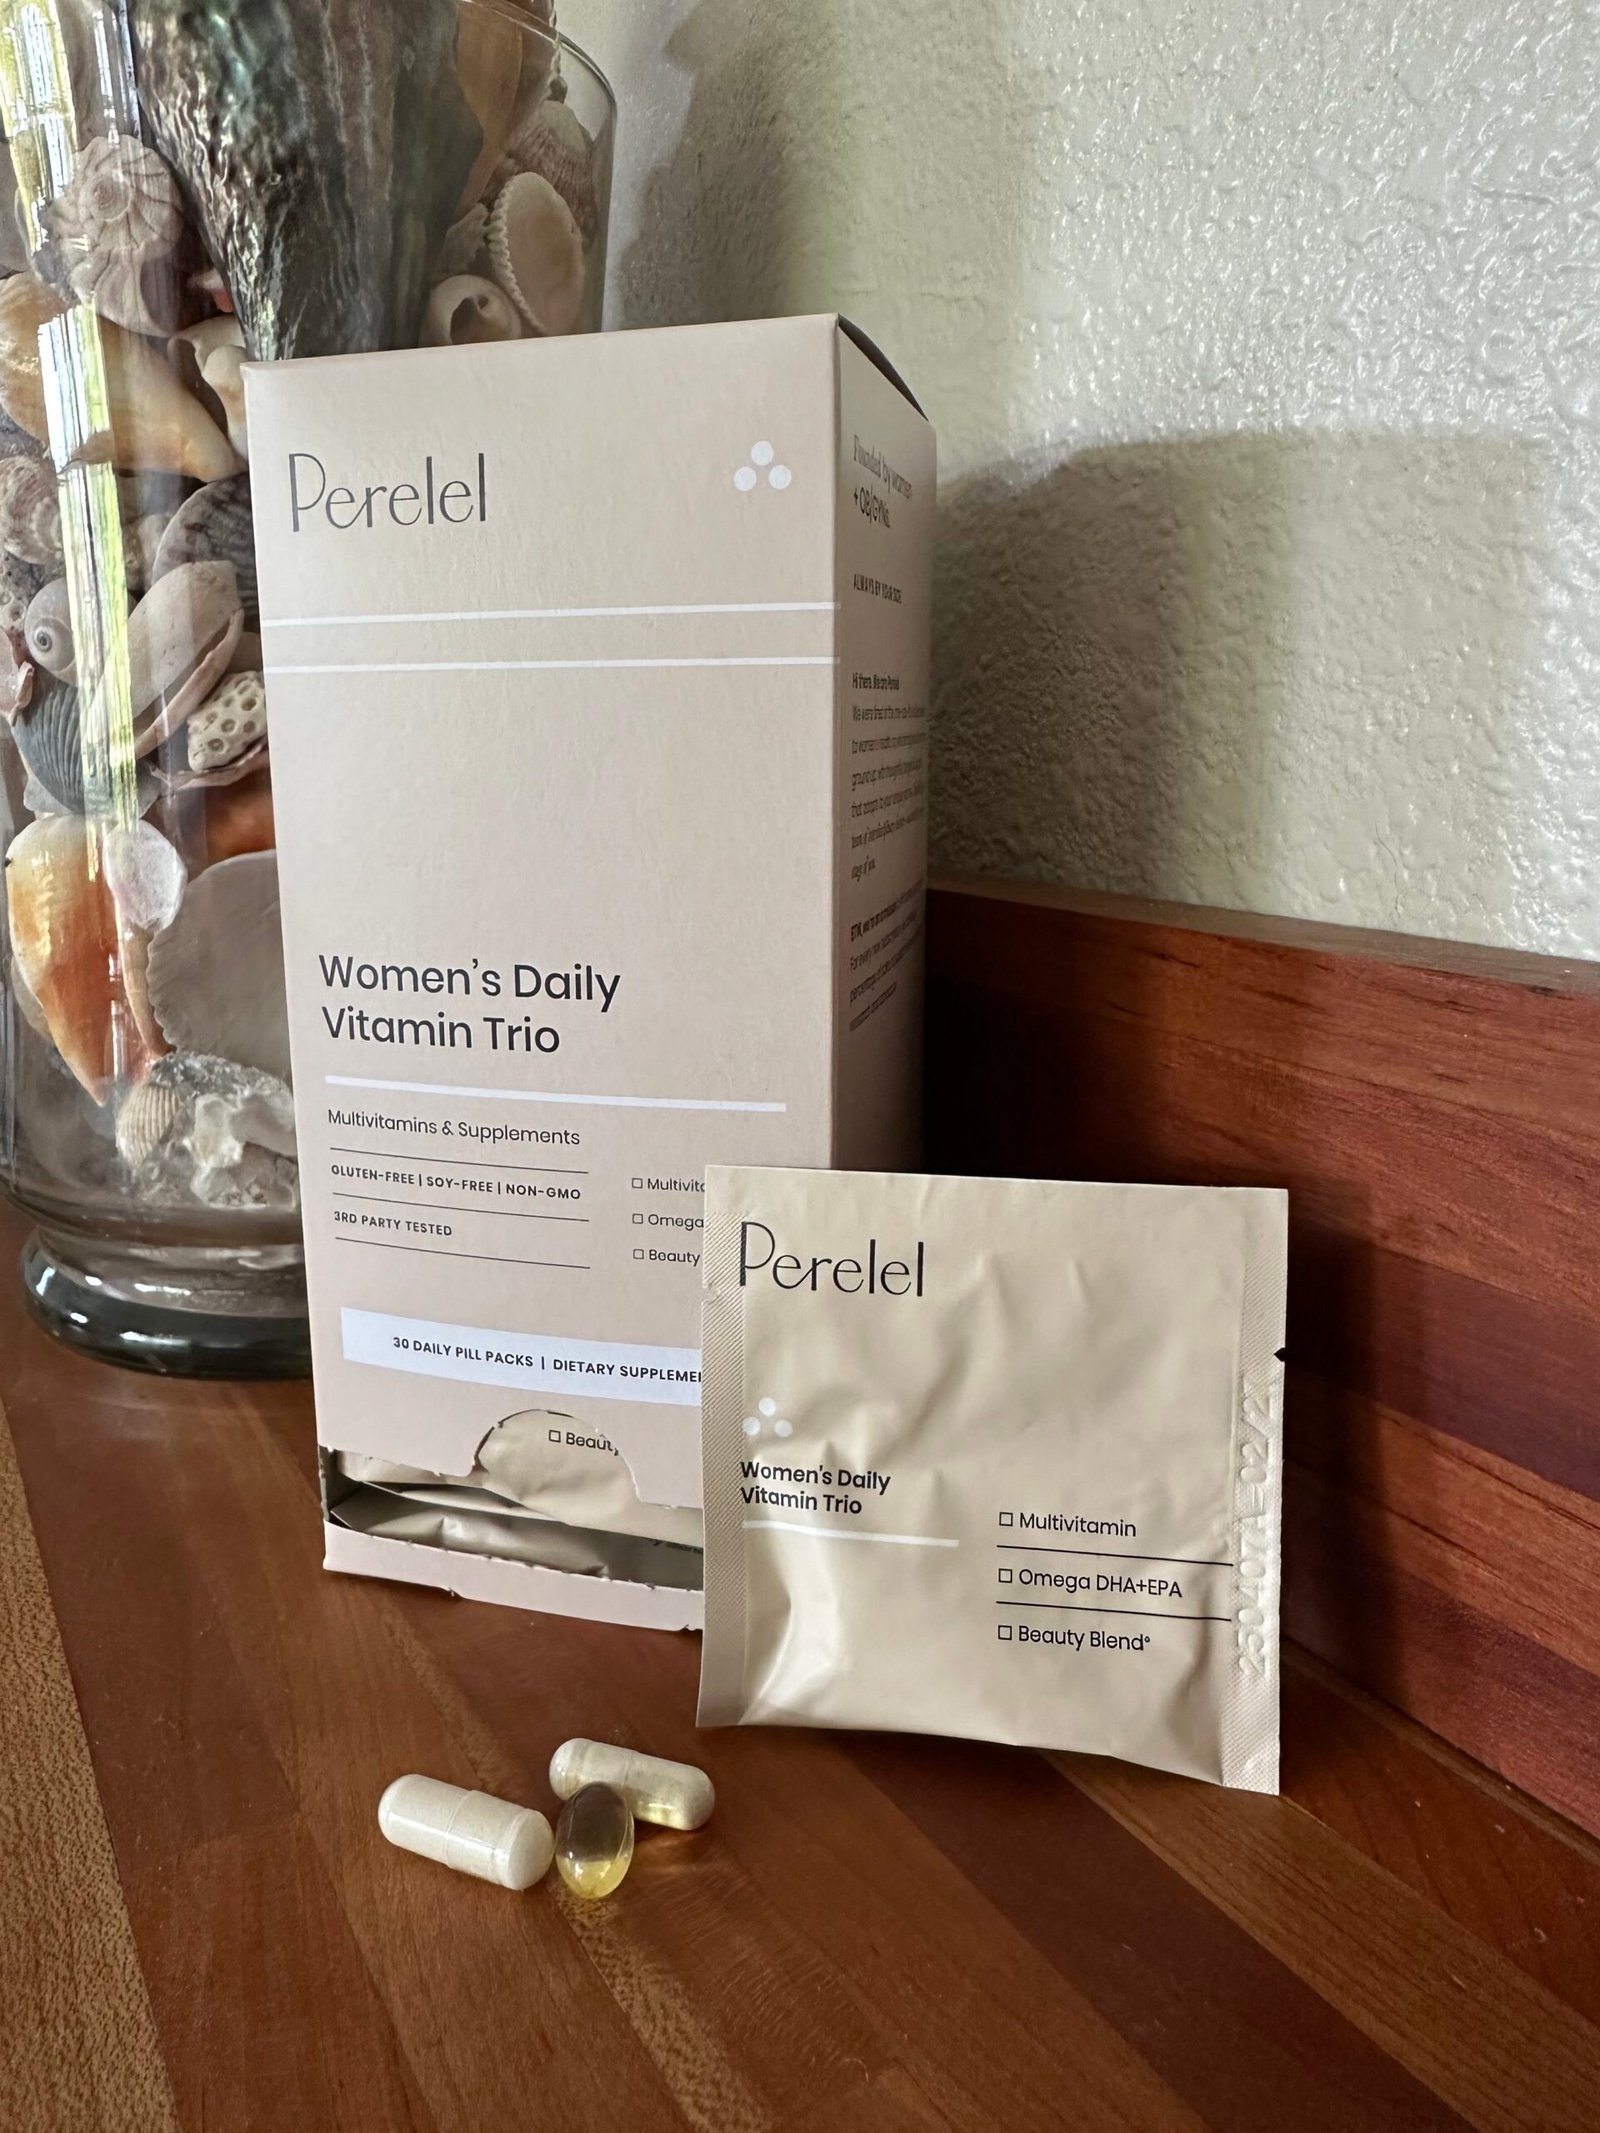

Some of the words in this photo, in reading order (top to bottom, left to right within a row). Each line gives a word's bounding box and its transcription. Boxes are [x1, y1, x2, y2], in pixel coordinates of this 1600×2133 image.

[289, 453, 486, 532] Perelel
[319, 954, 501, 997] Women’s
[514, 963, 621, 1013] Daily
[322, 1005, 472, 1049] Vitamin
[483, 1016, 561, 1053] Trio
[328, 1109, 437, 1135] Multivitamins
[441, 1120, 454, 1136] &
[458, 1122, 581, 1146] Supplements
[331, 1164, 415, 1185] GLUTEN-FREE
[426, 1175, 493, 1194] SOY-FREE
[506, 1183, 581, 1200] NON-GMO
[334, 1211, 358, 1225] 3RD
[361, 1214, 401, 1231] PARTY
[405, 1219, 453, 1236] TESTED
[648, 1213, 704, 1231] Omega
[649, 1249, 700, 1267] Beauty
[739, 1221, 924, 1297] Perelel
[393, 1337, 410, 1350] 30
[413, 1340, 451, 1356] DAILY
[455, 1346, 482, 1361] PILL
[485, 1351, 534, 1367] PACKS
[553, 1358, 615, 1376] DIETARY
[620, 1365, 701, 1383] SUPPLEME
[566, 1431, 619, 1456] Beaut
[741, 1461, 832, 1485] Women's
[838, 1469, 891, 1496] Daily
[741, 1486, 818, 1510] Vitamin
[823, 1494, 863, 1514] Trio
[1019, 1512, 1137, 1537] Multivitamin
[1019, 1568, 1091, 1593] Omega
[1096, 1574, 1183, 1598] DHA+EPA
[1019, 1625, 1085, 1651] Beauty
